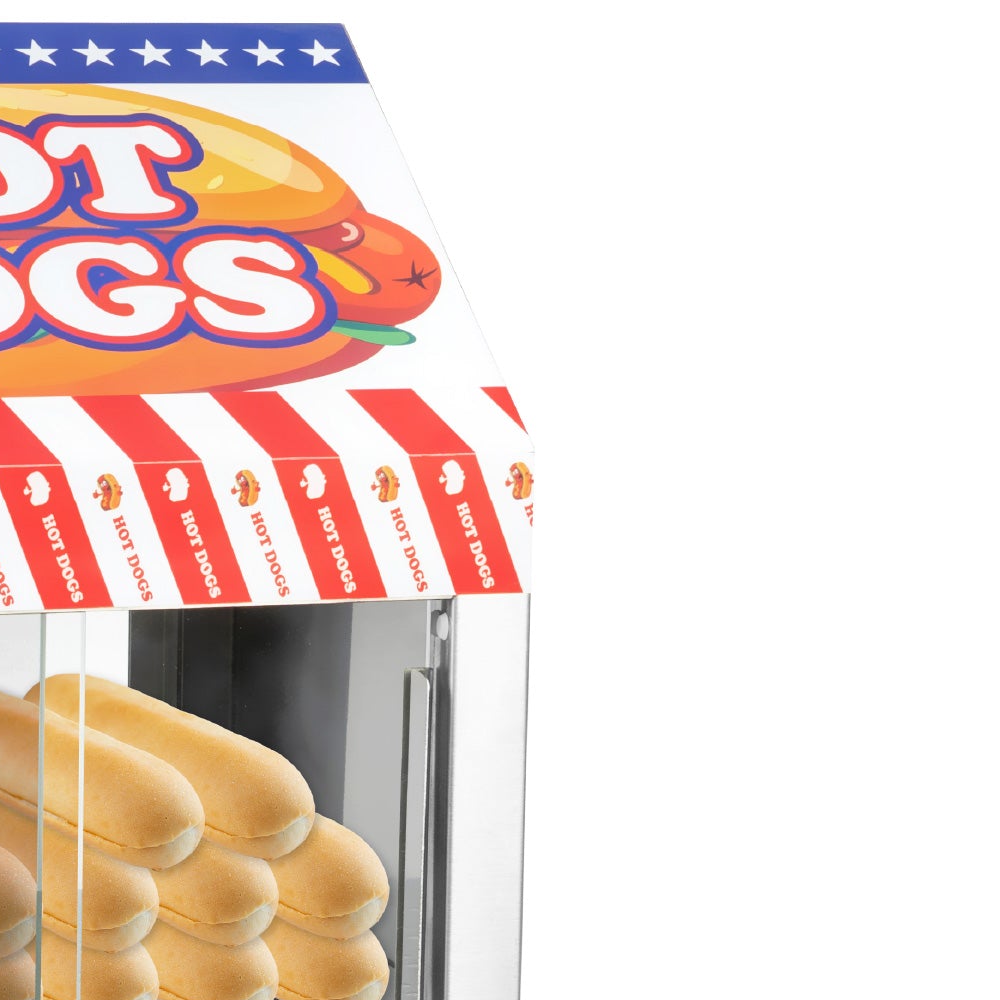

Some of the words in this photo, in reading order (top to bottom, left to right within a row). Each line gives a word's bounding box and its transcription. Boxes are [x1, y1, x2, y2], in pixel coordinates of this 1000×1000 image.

[42, 514, 65, 550] HOT
[57, 553, 83, 603] DOGS
[113, 515, 134, 550] HOT
[127, 553, 153, 602] DOGS
[181, 510, 203, 546] HOT
[195, 549, 222, 598] DOGS
[251, 512, 272, 546] HOT
[265, 549, 290, 597] DOGS
[318, 506, 339, 542] HOT
[332, 545, 357, 594] DOGS
[391, 508, 411, 541] HOT
[404, 545, 428, 592] DOGS
[457, 502, 478, 538] HOT
[471, 541, 495, 589] DOGS
